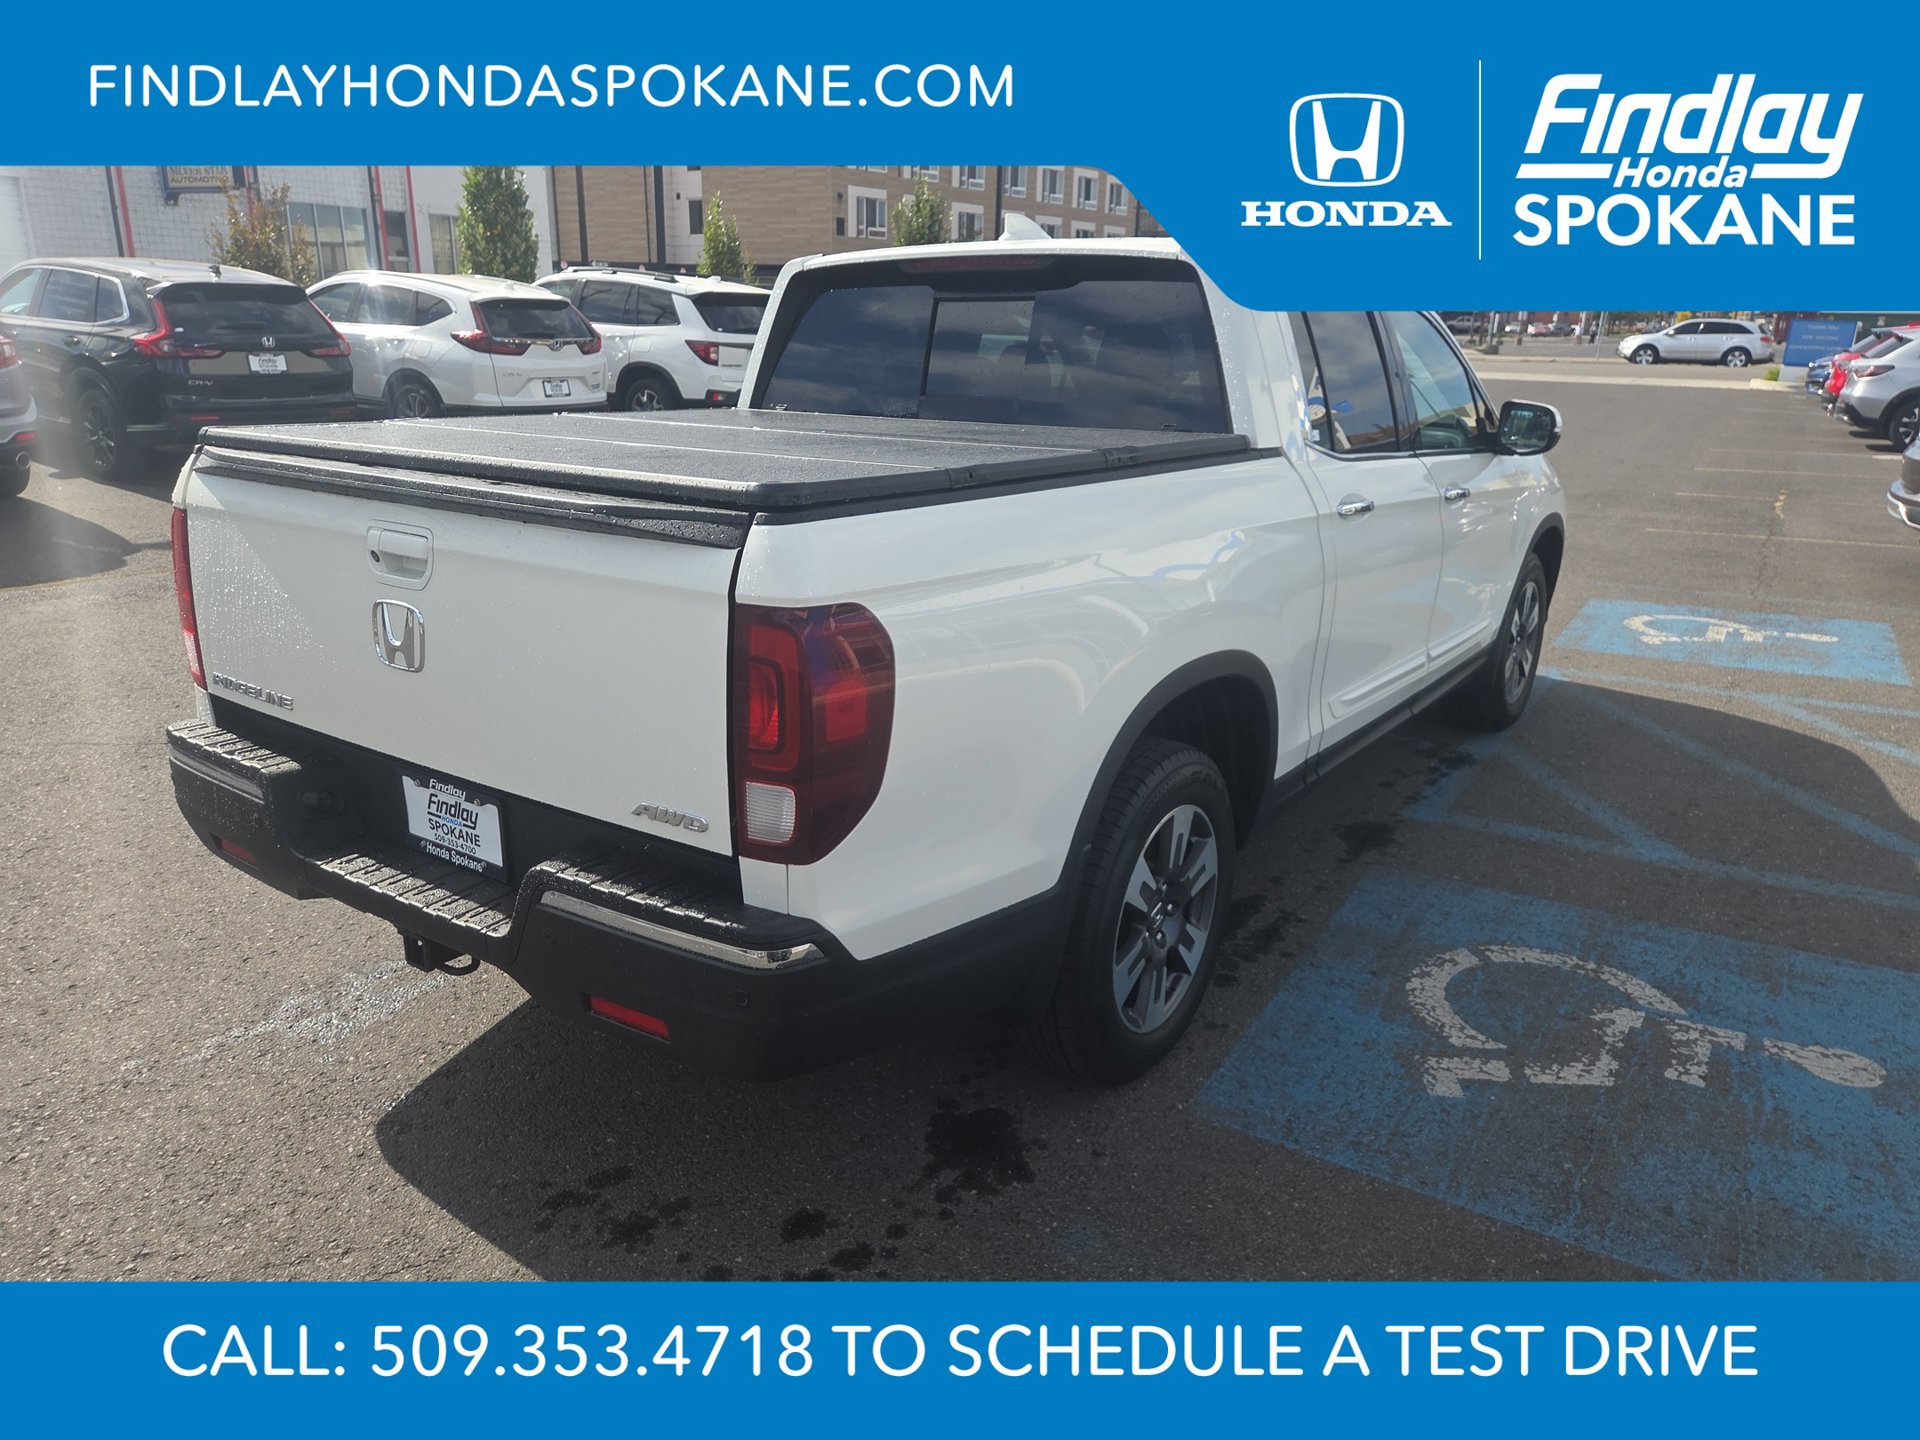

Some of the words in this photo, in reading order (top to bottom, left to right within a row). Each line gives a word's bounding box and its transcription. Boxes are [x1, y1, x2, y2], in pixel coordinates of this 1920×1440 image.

[212, 671, 294, 712] RIDGELINE
[429, 779, 466, 800] Findlay
[427, 793, 478, 830] Findlay
[442, 816, 463, 827] HONDA
[630, 801, 710, 833] AWD
[428, 818, 480, 847] SPOKANE
[434, 833, 476, 854] 509-353-4700
[426, 841, 449, 859] Honda
[450, 850, 483, 872] Spokane
